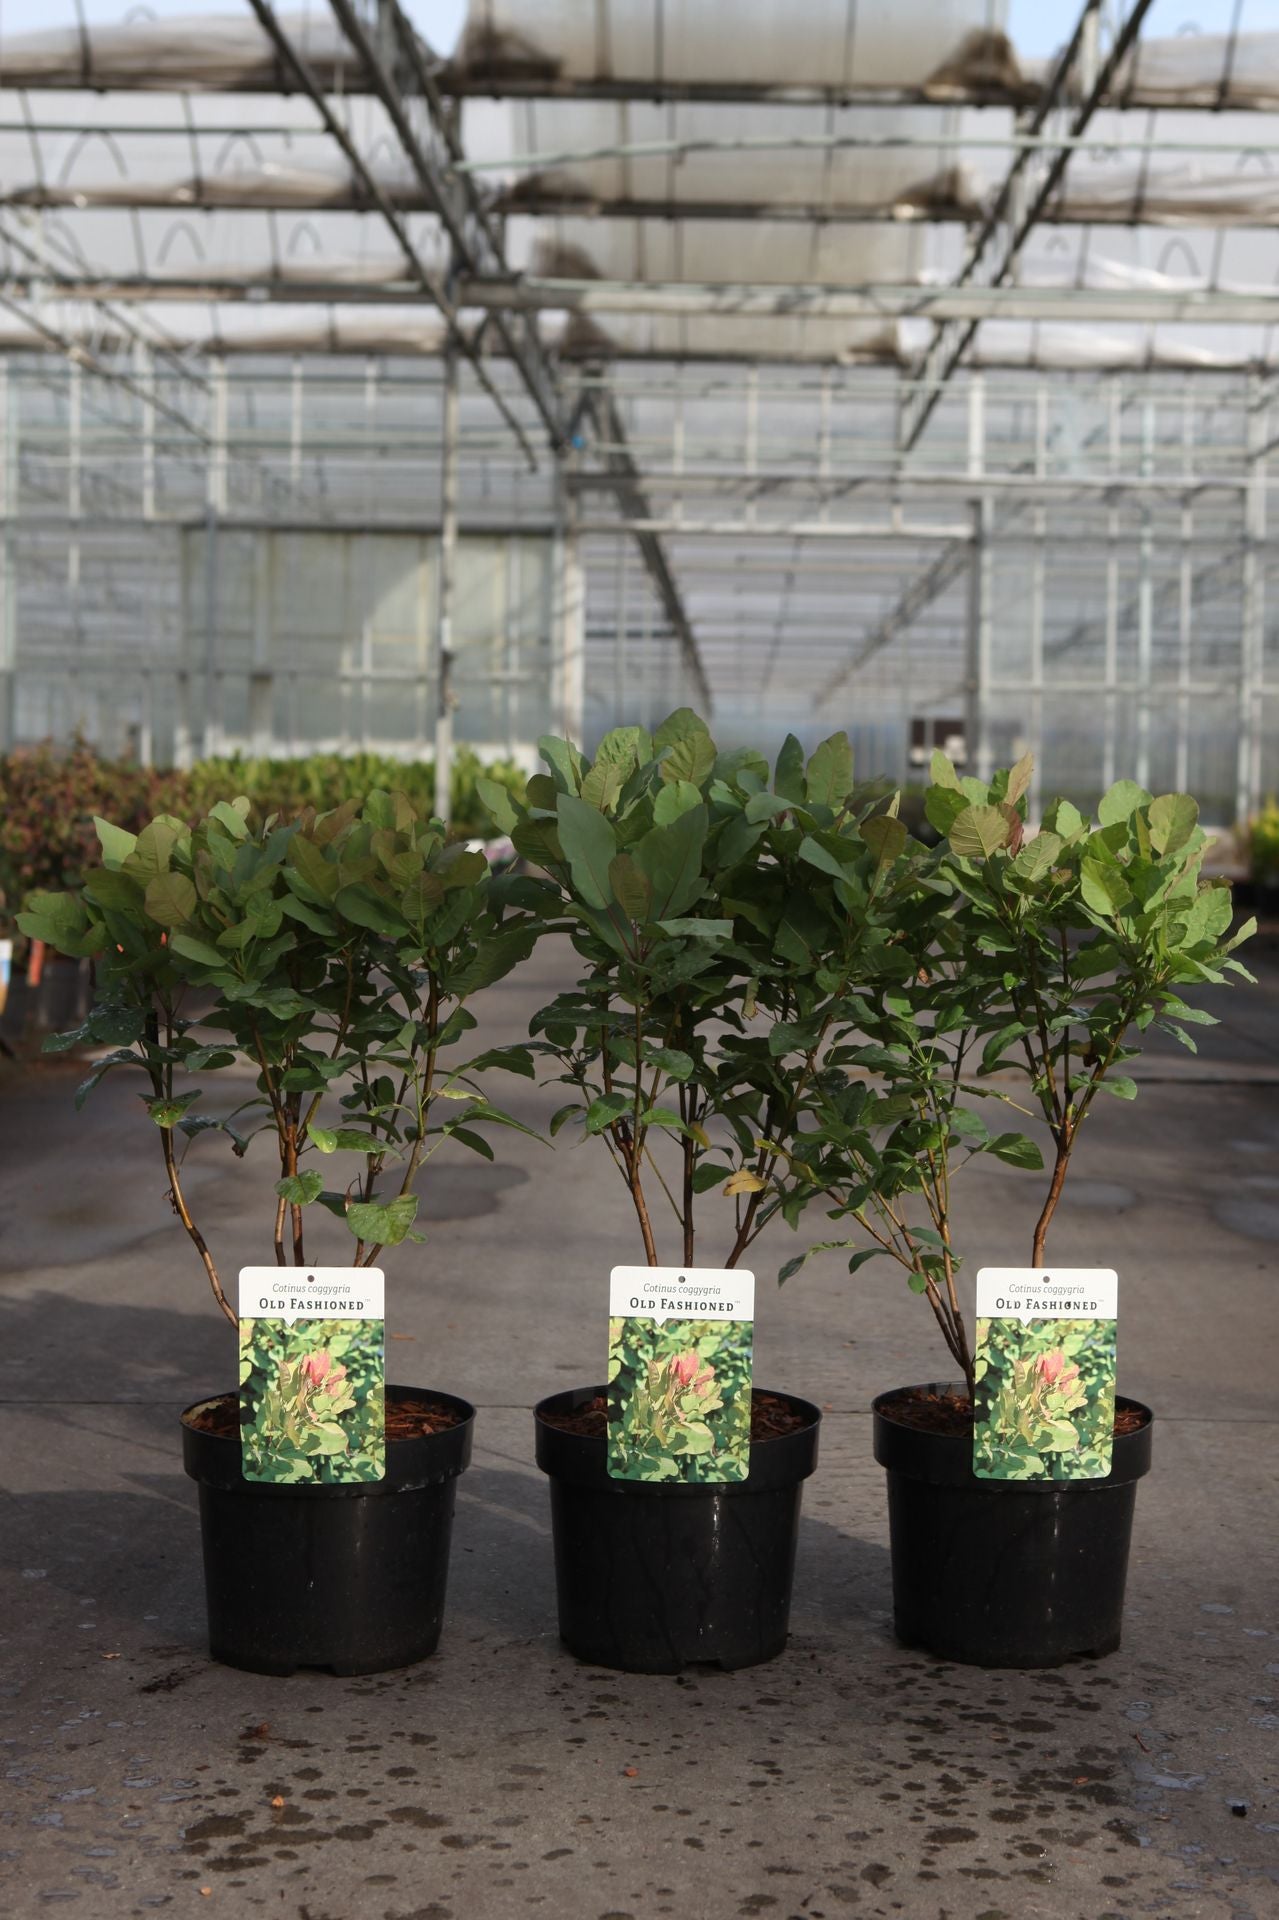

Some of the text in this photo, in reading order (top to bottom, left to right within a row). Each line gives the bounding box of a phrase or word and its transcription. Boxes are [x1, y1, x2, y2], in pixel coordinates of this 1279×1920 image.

[272, 1283, 351, 1295] Cotinus coggygria
[643, 1283, 721, 1296] Cotinus coggygria
[1008, 1283, 1085, 1296] Cotinus coggygria
[259, 1297, 285, 1310] OLD
[629, 1297, 656, 1309] OLD
[995, 1297, 1021, 1310] OLD
